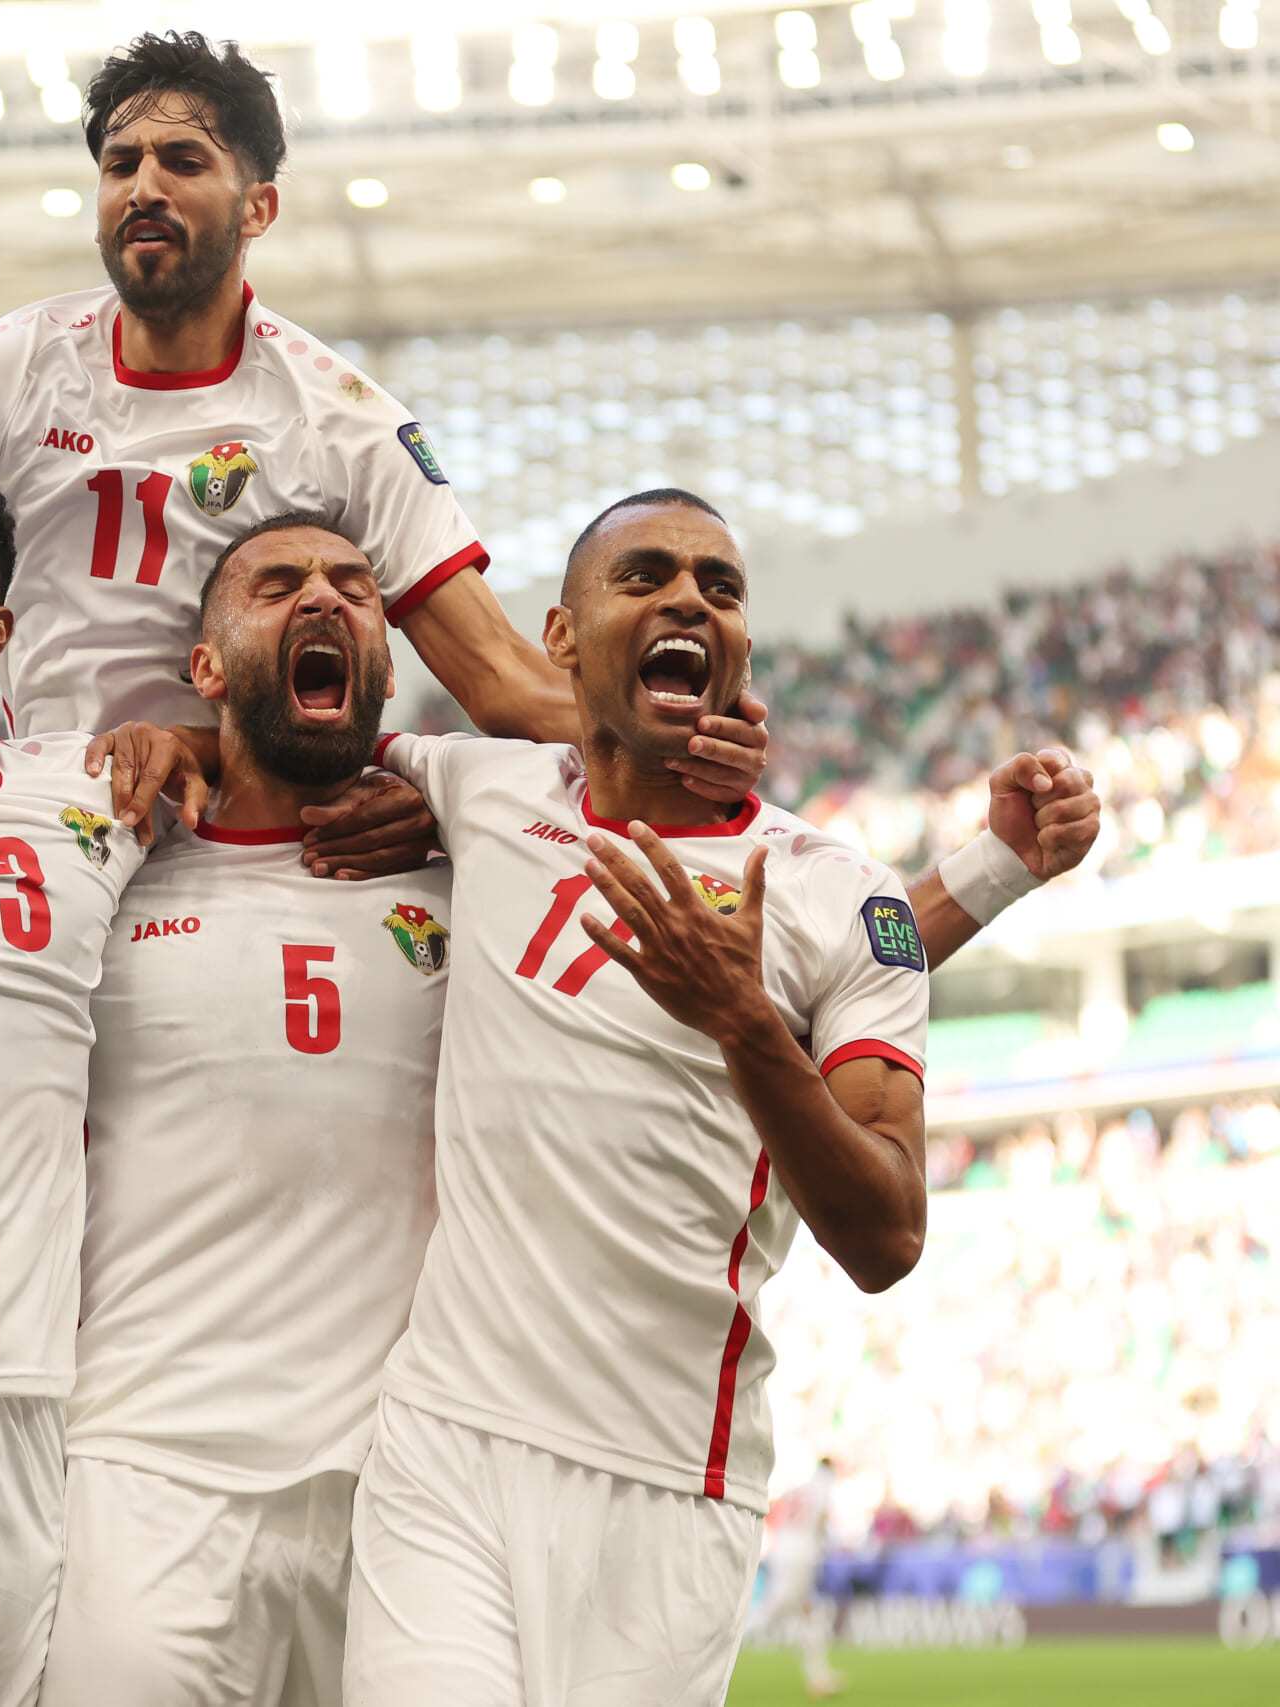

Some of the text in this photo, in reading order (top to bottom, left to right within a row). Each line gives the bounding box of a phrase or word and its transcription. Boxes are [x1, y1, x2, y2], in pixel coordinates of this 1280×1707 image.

[87, 469, 173, 586] 11
[522, 821, 579, 844] JAKO
[873, 907, 899, 920] AFC
[130, 916, 201, 943] JAKO
[874, 919, 916, 943] LIVE
[282, 944, 341, 1055] 5
